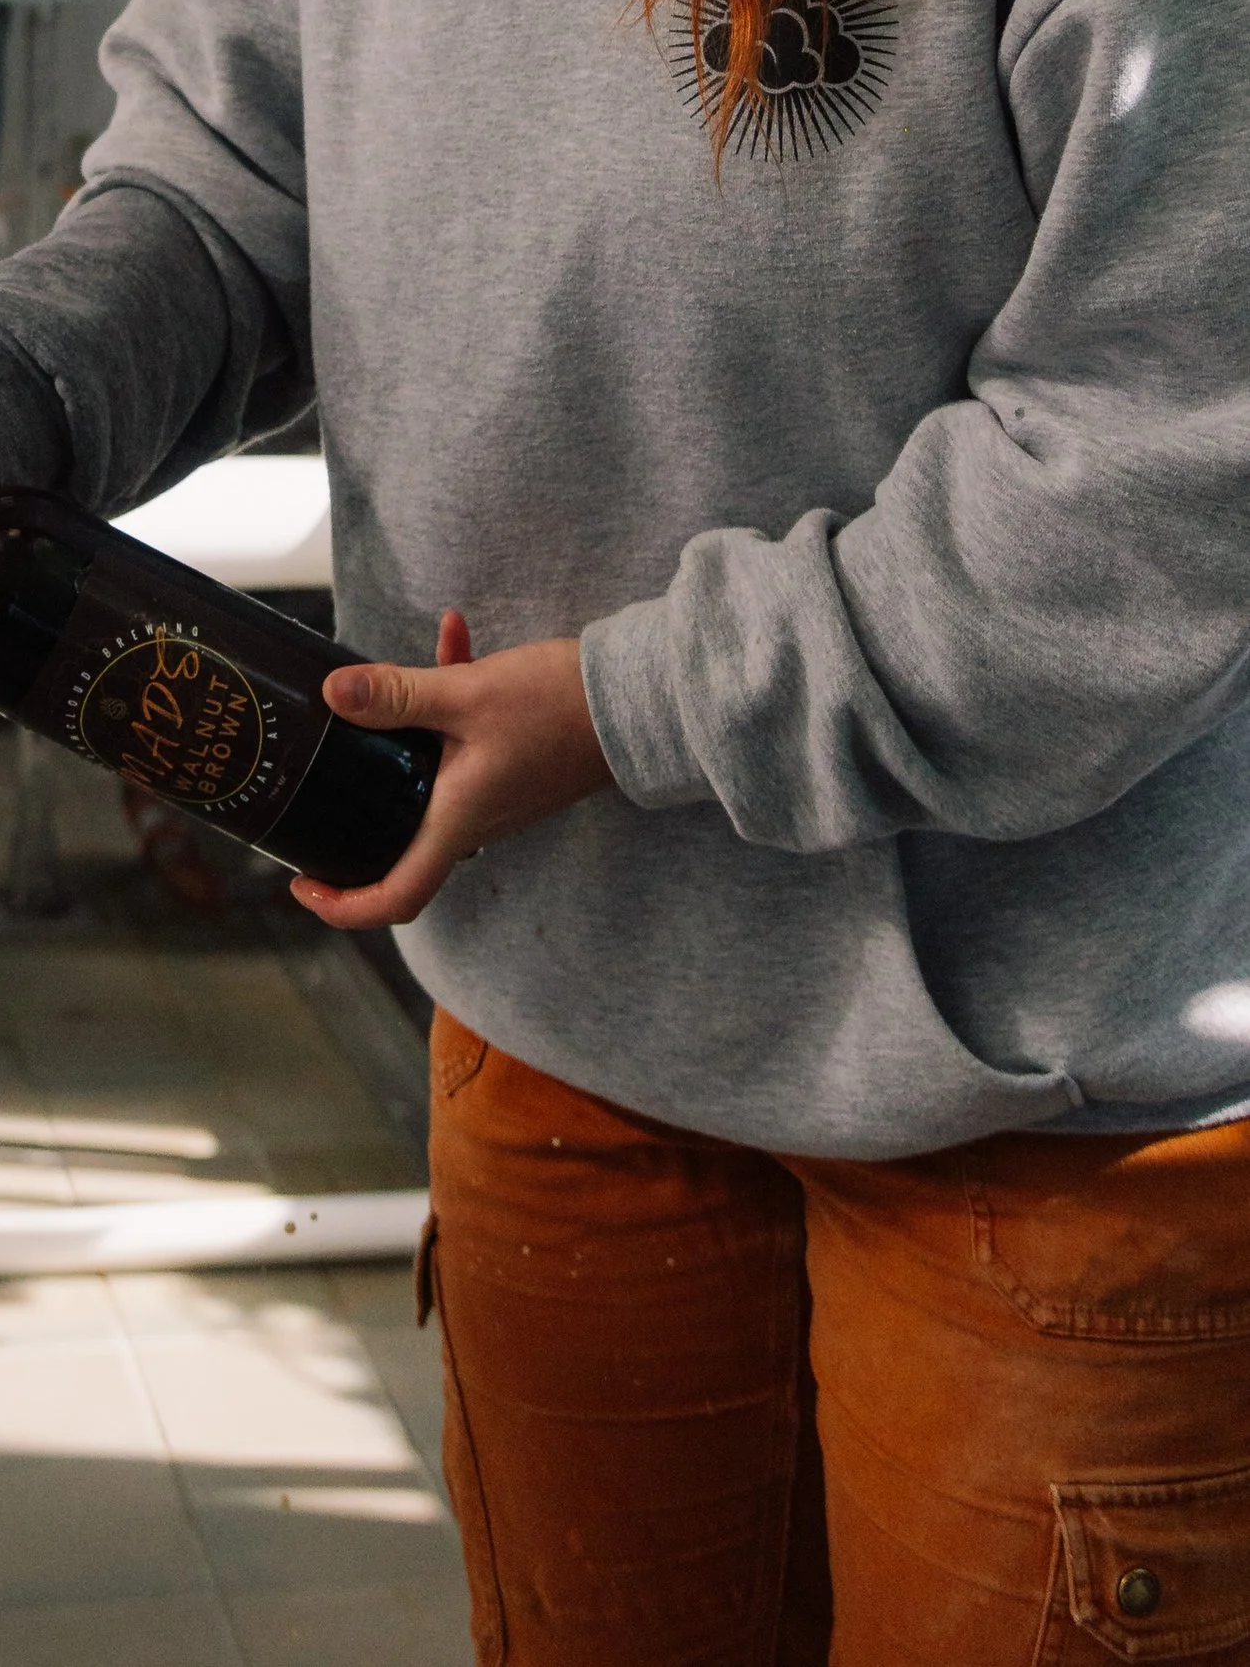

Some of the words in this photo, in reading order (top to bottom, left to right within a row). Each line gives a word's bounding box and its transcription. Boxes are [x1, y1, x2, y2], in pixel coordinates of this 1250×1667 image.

[174, 674, 230, 792] WALNUT
[197, 692, 249, 796] BROWN
[262, 700, 279, 740] ALE
